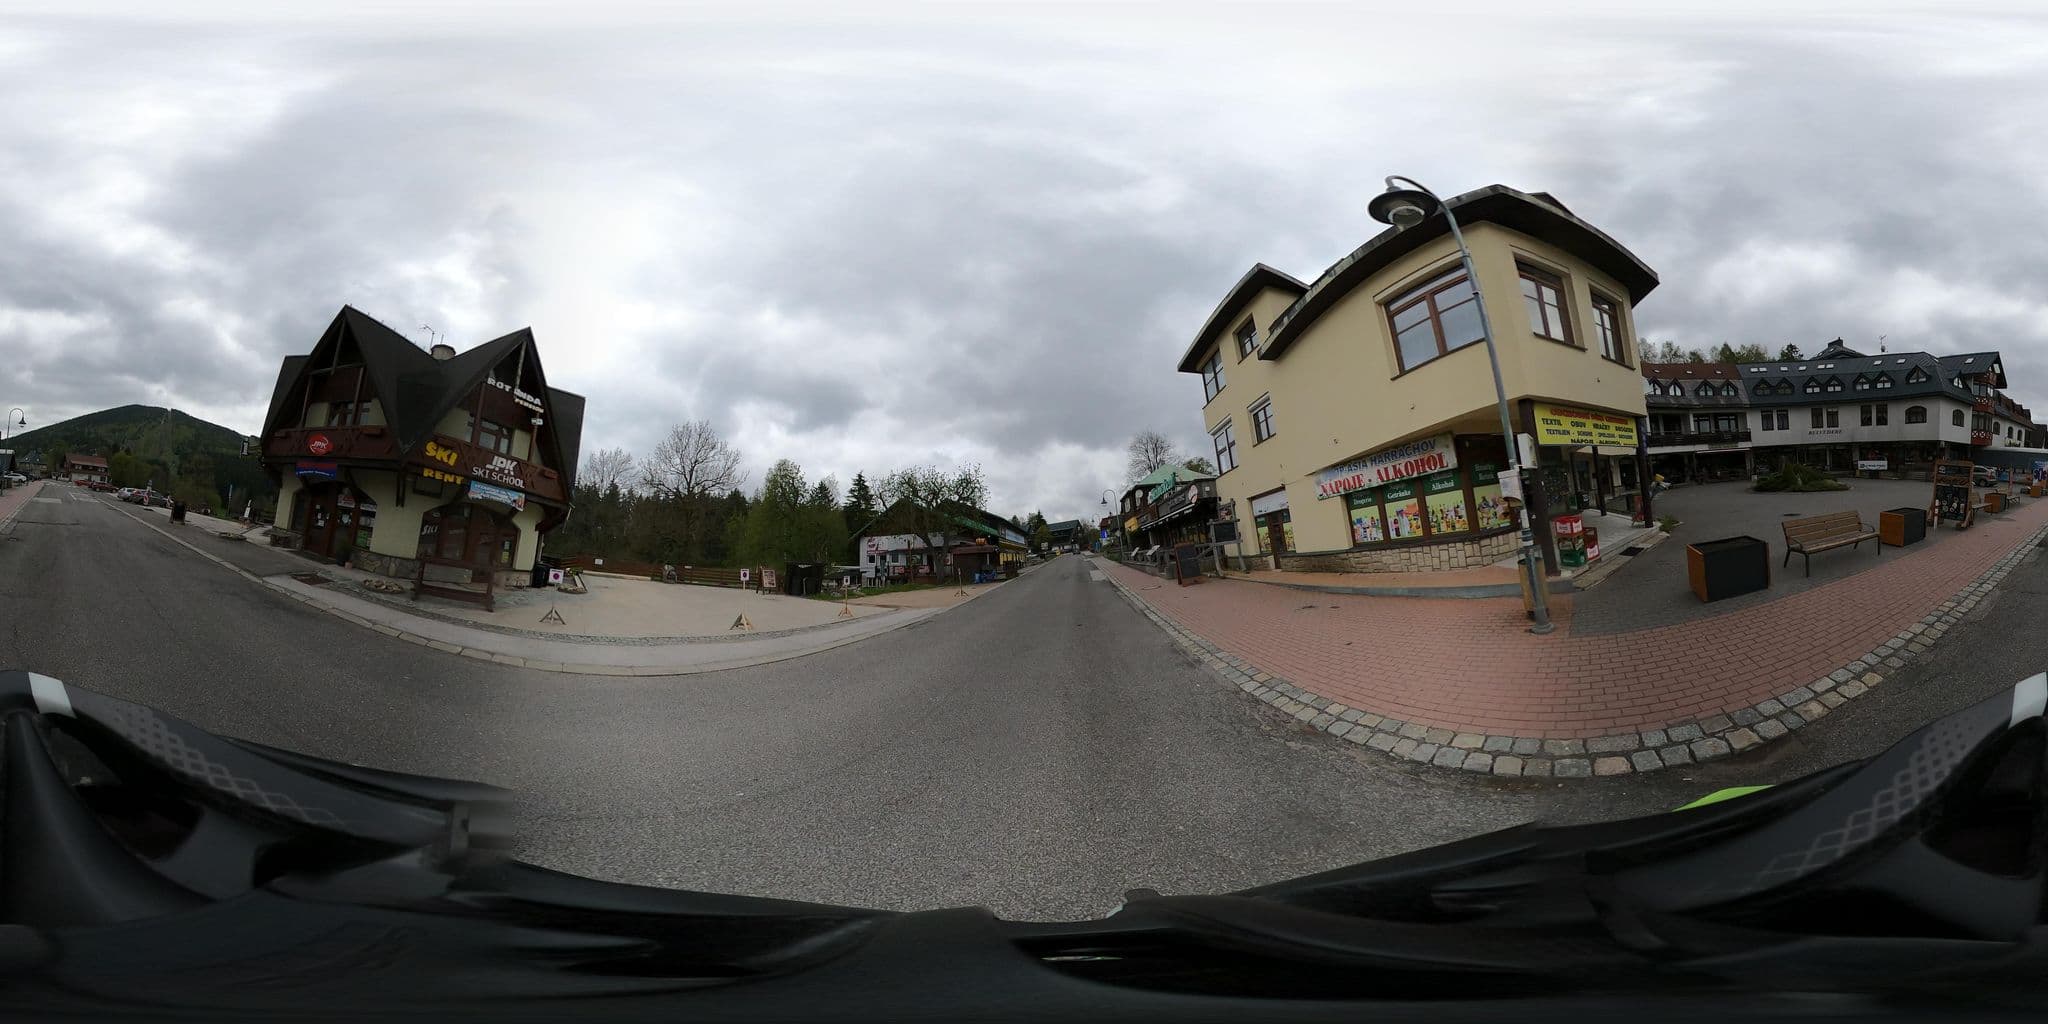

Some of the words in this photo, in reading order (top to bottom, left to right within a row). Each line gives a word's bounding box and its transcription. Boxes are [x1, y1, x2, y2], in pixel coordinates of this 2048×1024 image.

[1541, 417, 1563, 427] TEXTIL
[425, 441, 458, 467] SKI
[1370, 439, 1436, 466] HARRACHOV
[423, 467, 464, 485] RENT
[486, 455, 518, 475] JPK
[1376, 453, 1448, 482] ALKOHOL
[472, 466, 491, 479] SKI
[491, 472, 525, 488] SCHOOL
